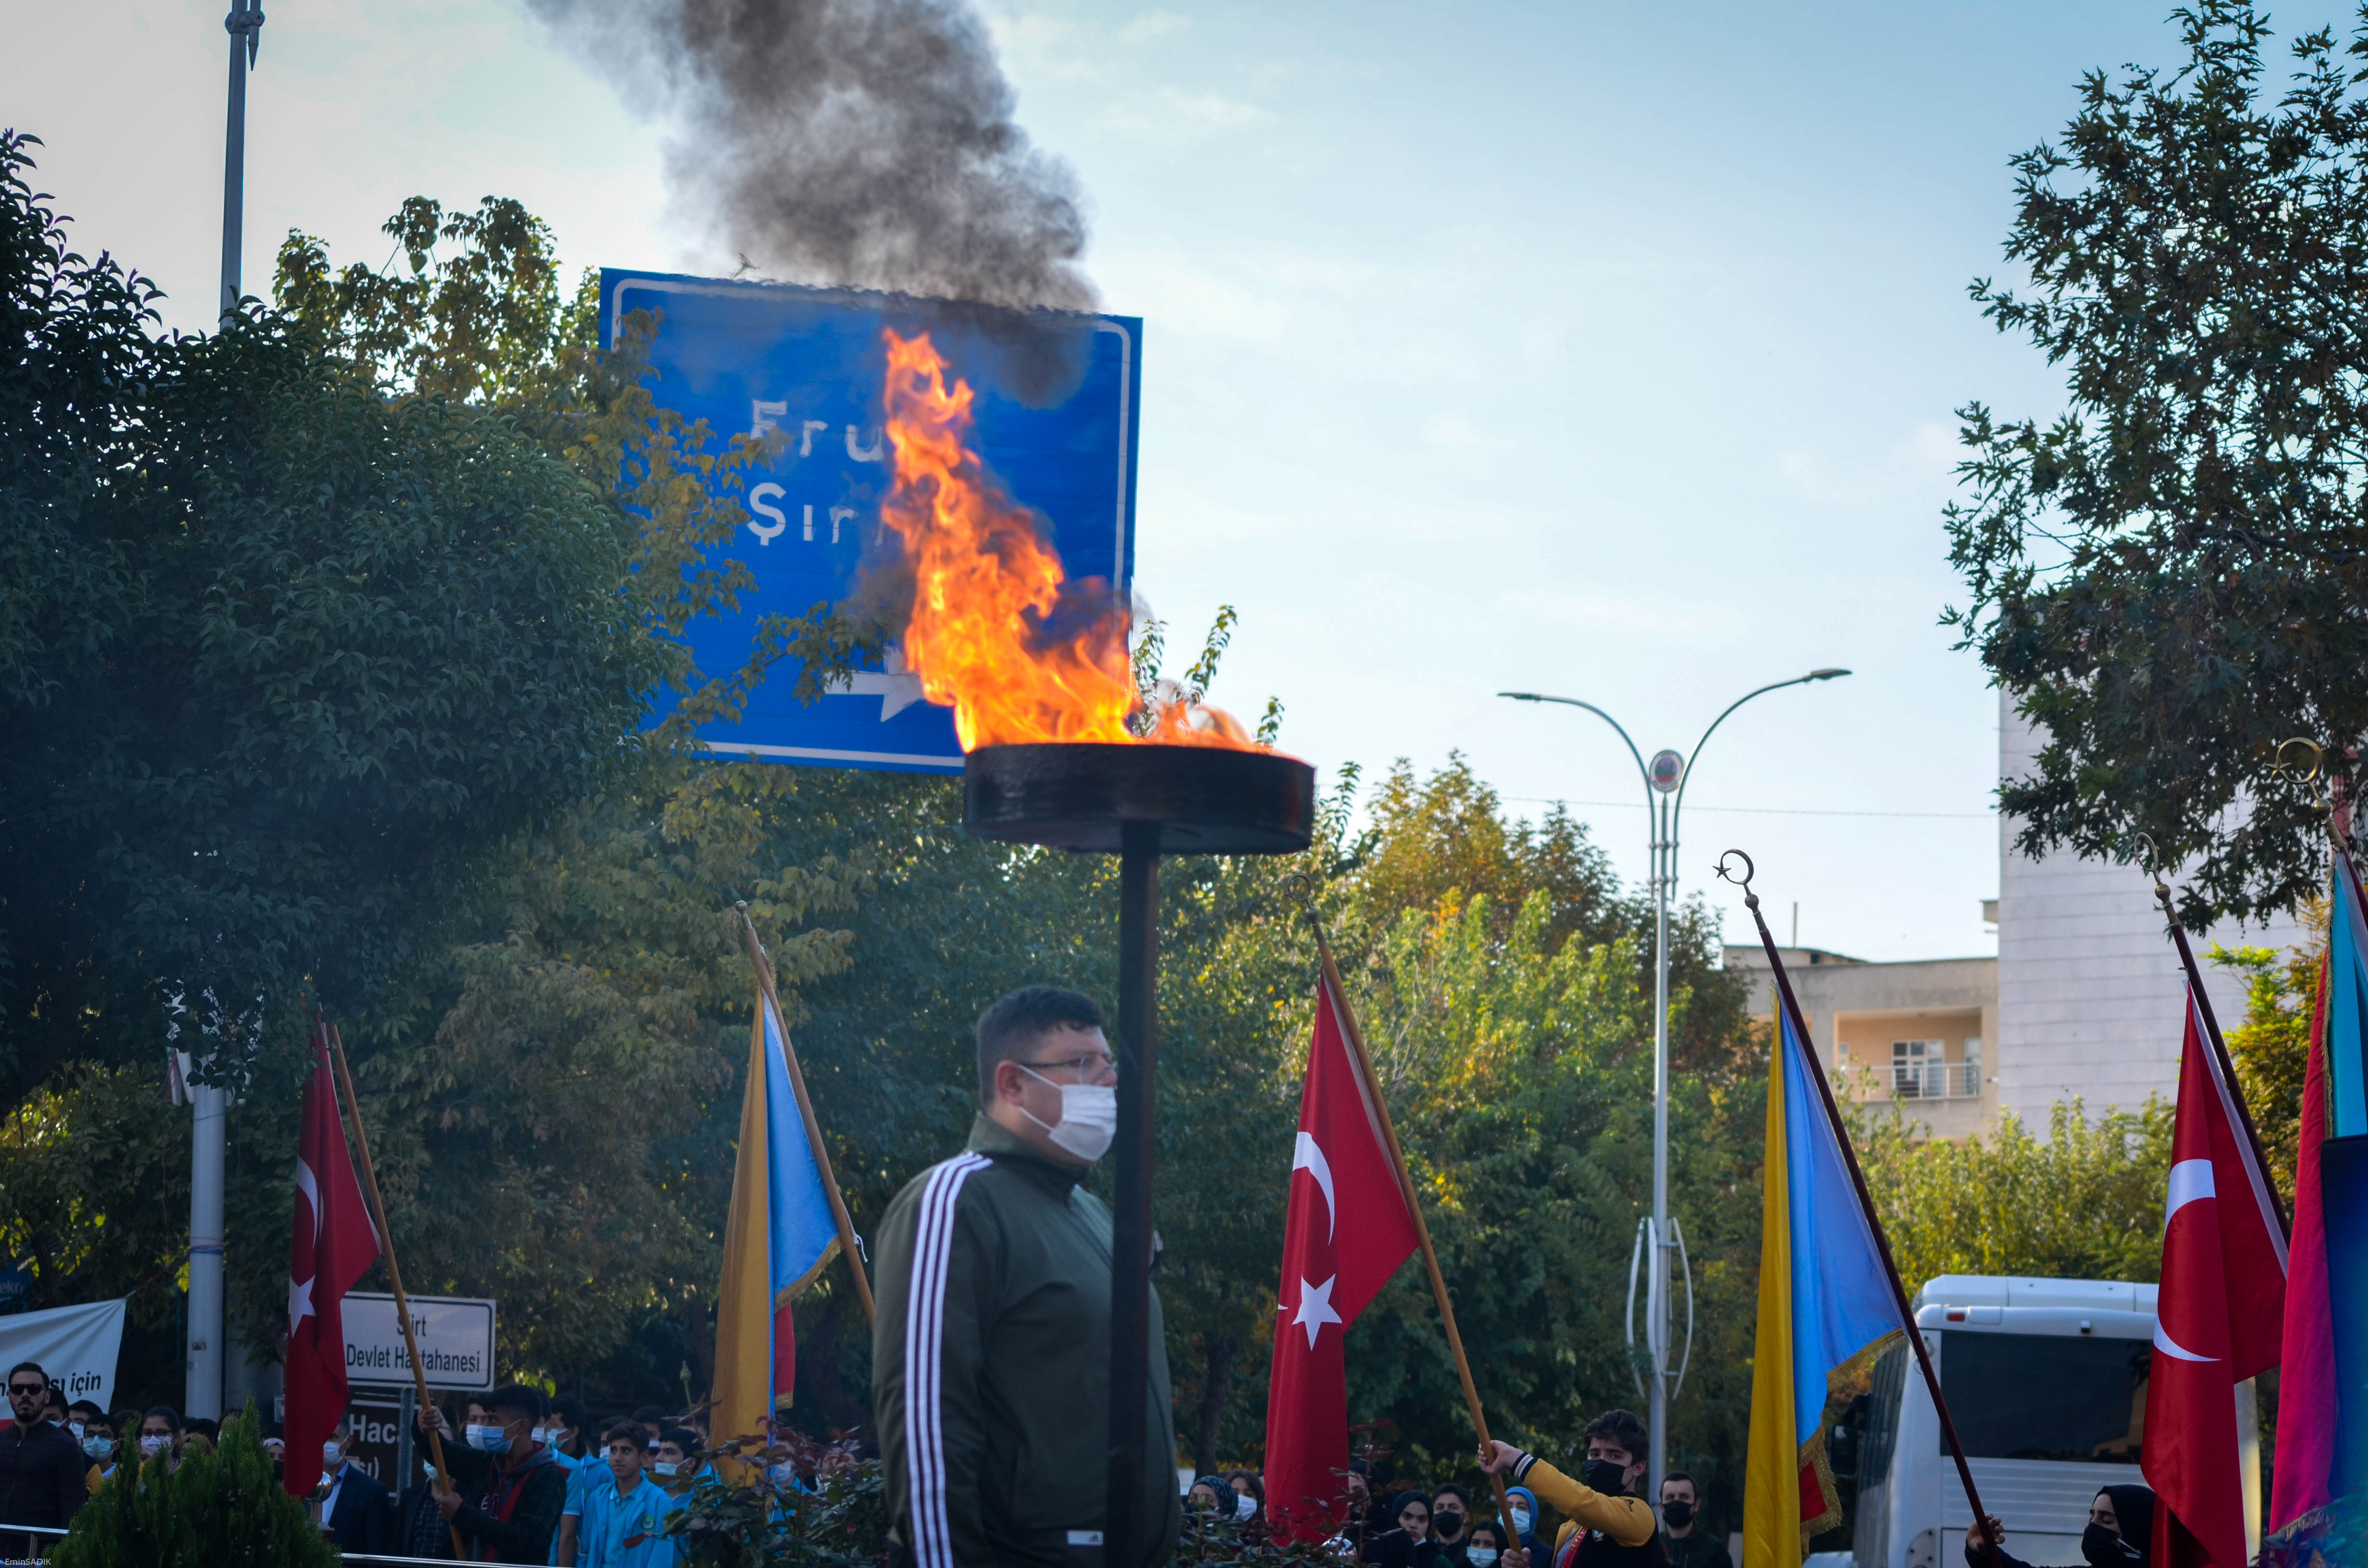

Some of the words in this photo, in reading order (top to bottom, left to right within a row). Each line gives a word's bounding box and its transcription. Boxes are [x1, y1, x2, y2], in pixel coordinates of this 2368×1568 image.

[748, 482, 885, 546] Şır
[397, 1314, 427, 1337] Sirt
[346, 1344, 390, 1369] Devlet
[395, 1346, 480, 1373] Hatahanesi
[70, 1371, 101, 1396] için
[349, 1413, 401, 1444] Hac
